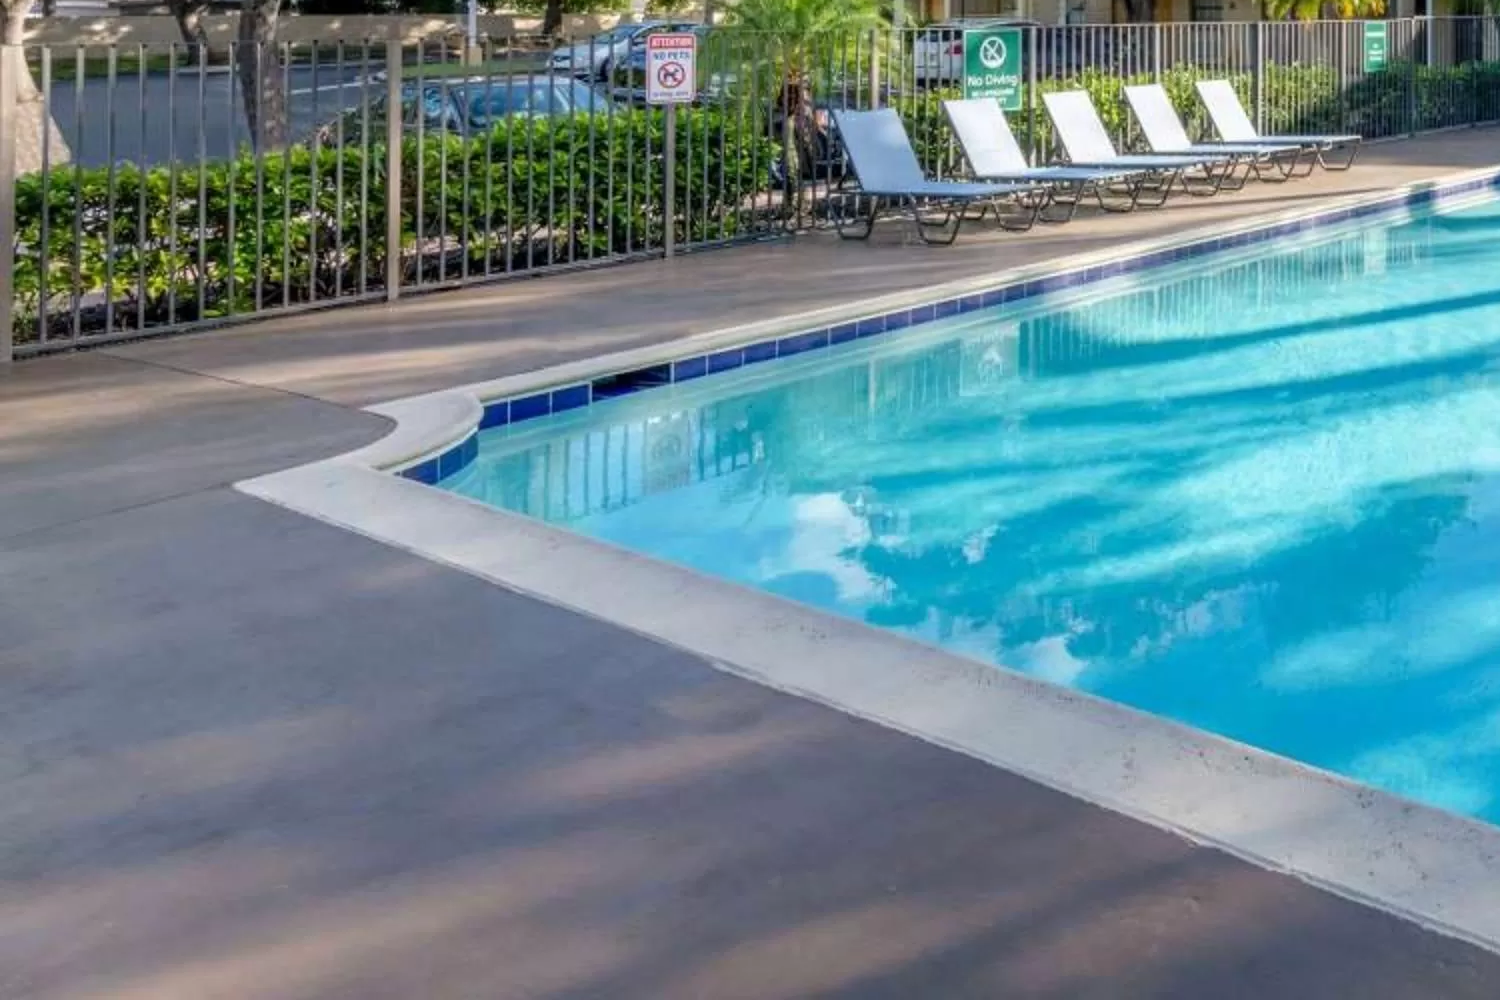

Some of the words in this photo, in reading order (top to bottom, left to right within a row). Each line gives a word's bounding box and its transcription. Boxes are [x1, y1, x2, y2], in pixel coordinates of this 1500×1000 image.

[654, 51, 666, 60] NO
[668, 51, 690, 60] PETS
[967, 75, 983, 87] No
[985, 73, 1017, 87] Diving
